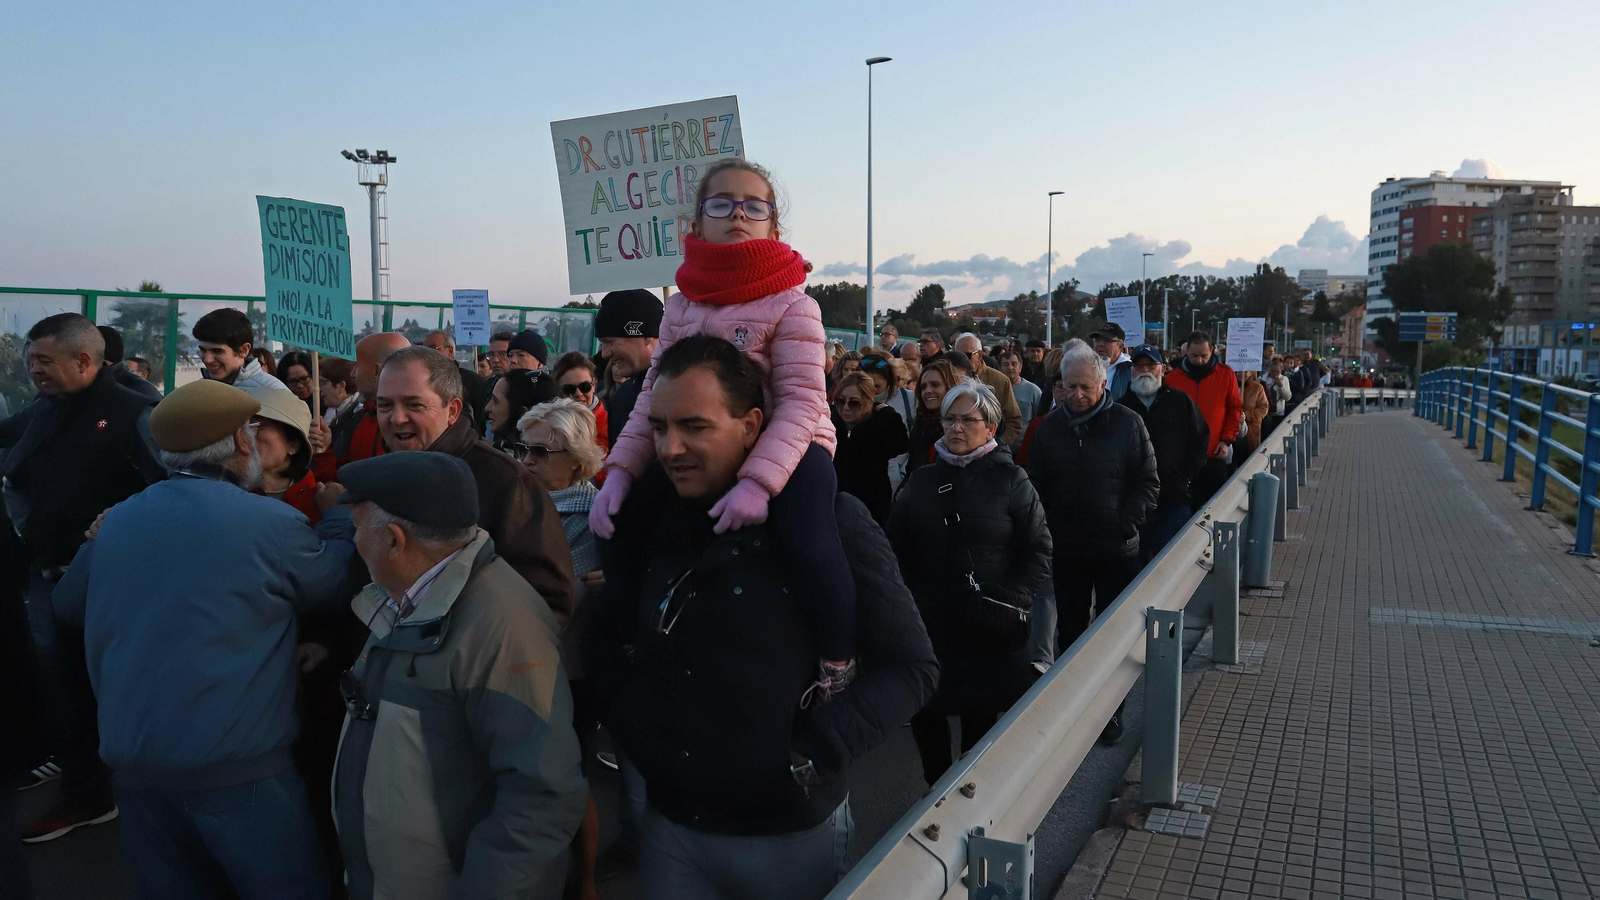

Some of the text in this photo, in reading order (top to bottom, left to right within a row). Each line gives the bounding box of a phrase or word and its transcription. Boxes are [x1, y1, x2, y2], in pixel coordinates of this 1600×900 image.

[265, 203, 346, 252] GERENTE
[575, 226, 612, 265] TE
[304, 292, 314, 317] A
[317, 294, 332, 321] LA
